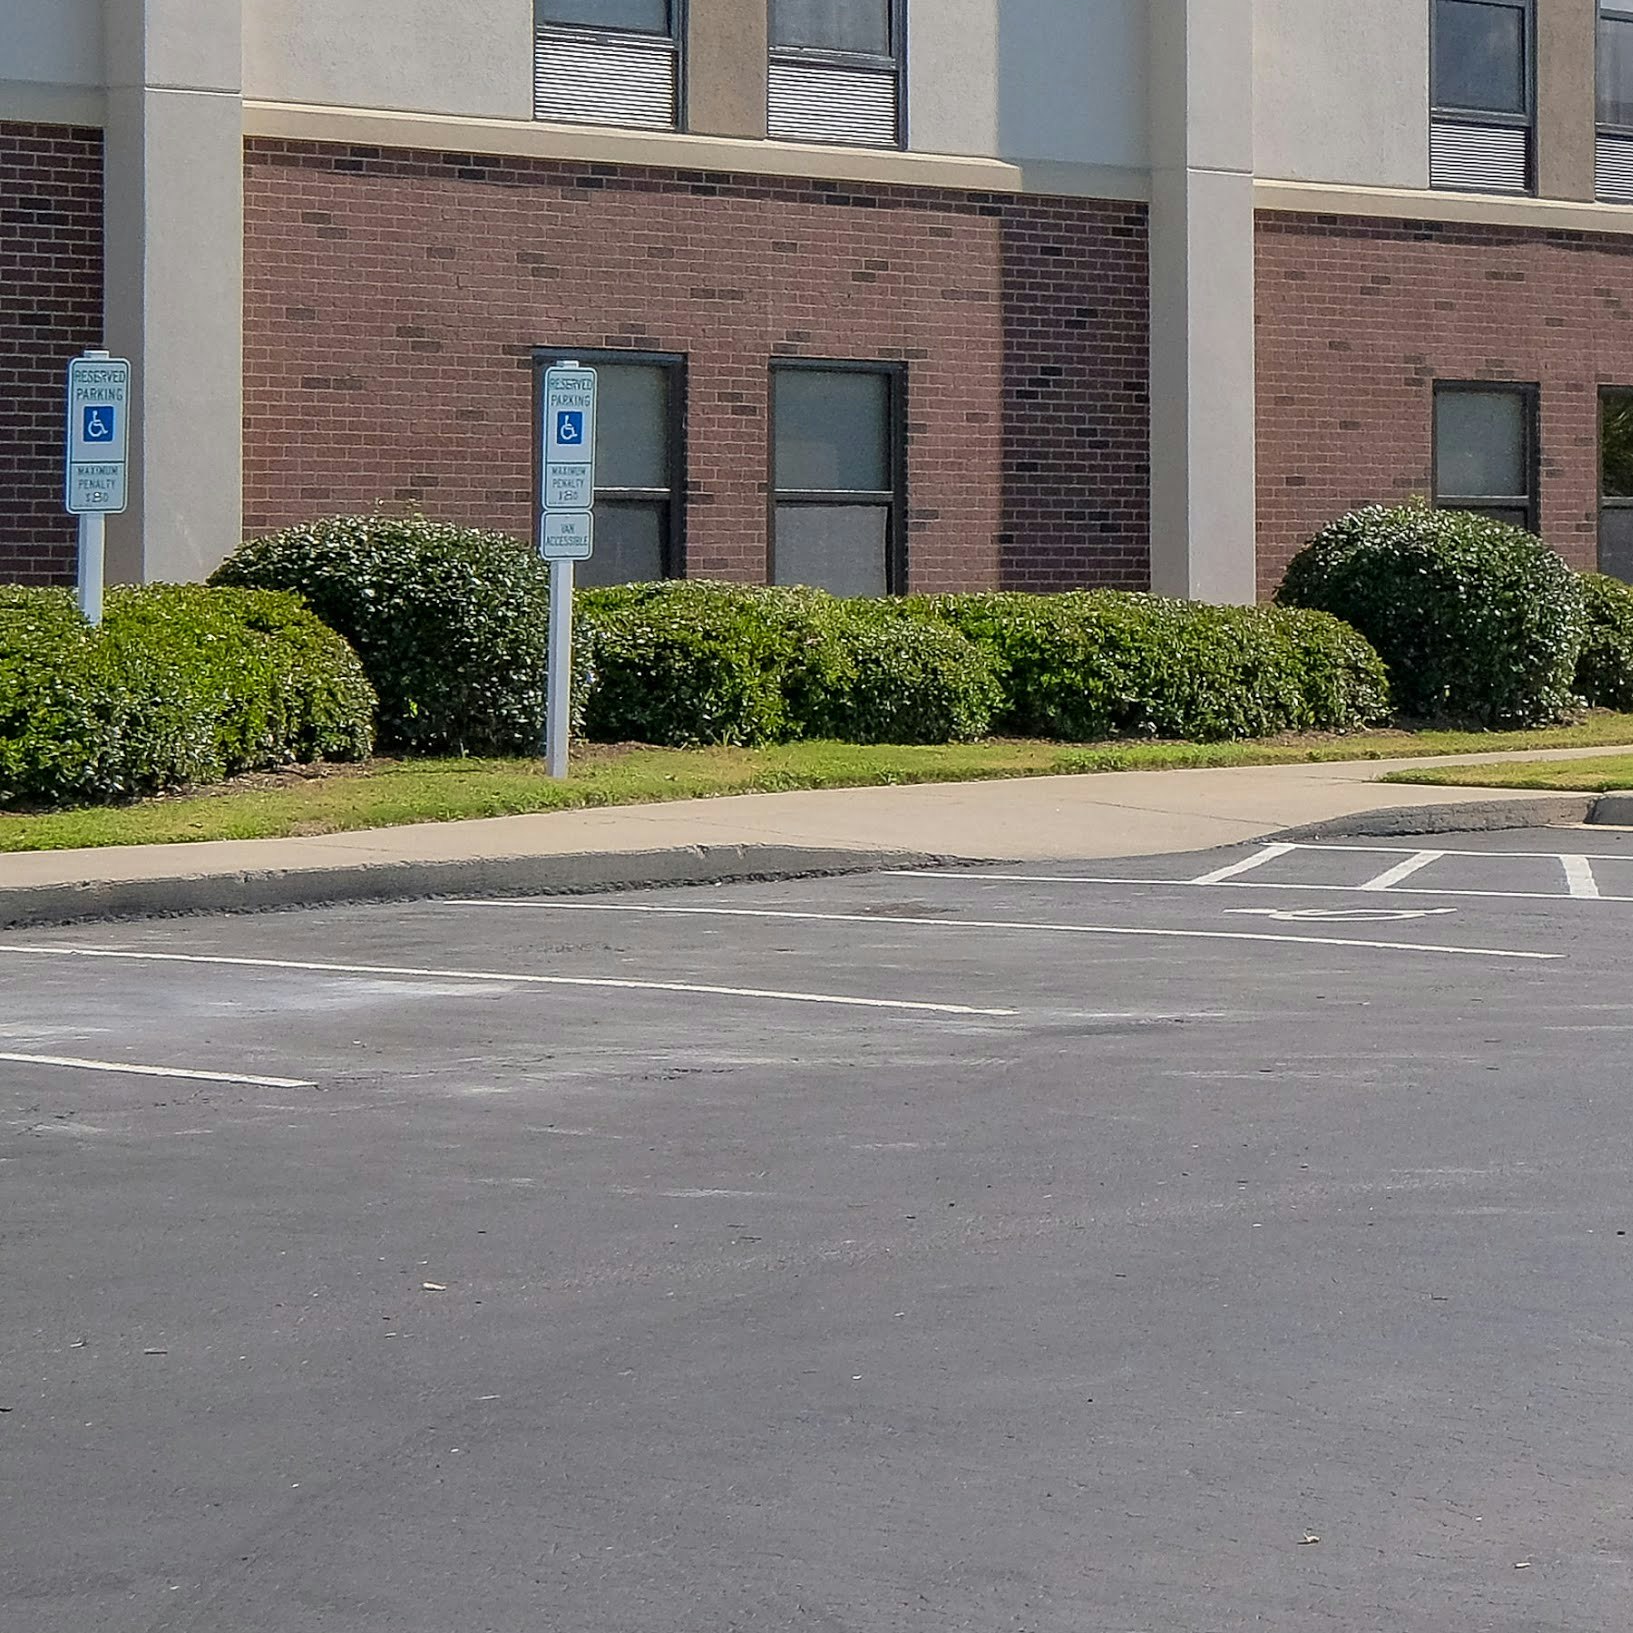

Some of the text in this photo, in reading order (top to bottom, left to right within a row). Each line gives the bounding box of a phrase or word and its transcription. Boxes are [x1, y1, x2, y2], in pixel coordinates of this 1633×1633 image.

[75, 370, 126, 383] RESERVED
[549, 378, 592, 390] RESERVED
[76, 388, 123, 401] PARKING
[551, 394, 590, 406] PARKING
[78, 466, 118, 475] MAXIMUM
[78, 479, 116, 489] PENALTY
[552, 478, 584, 488] PENALTY
[561, 523, 576, 534] VAN
[546, 535, 588, 546] ACCESSIBLE
